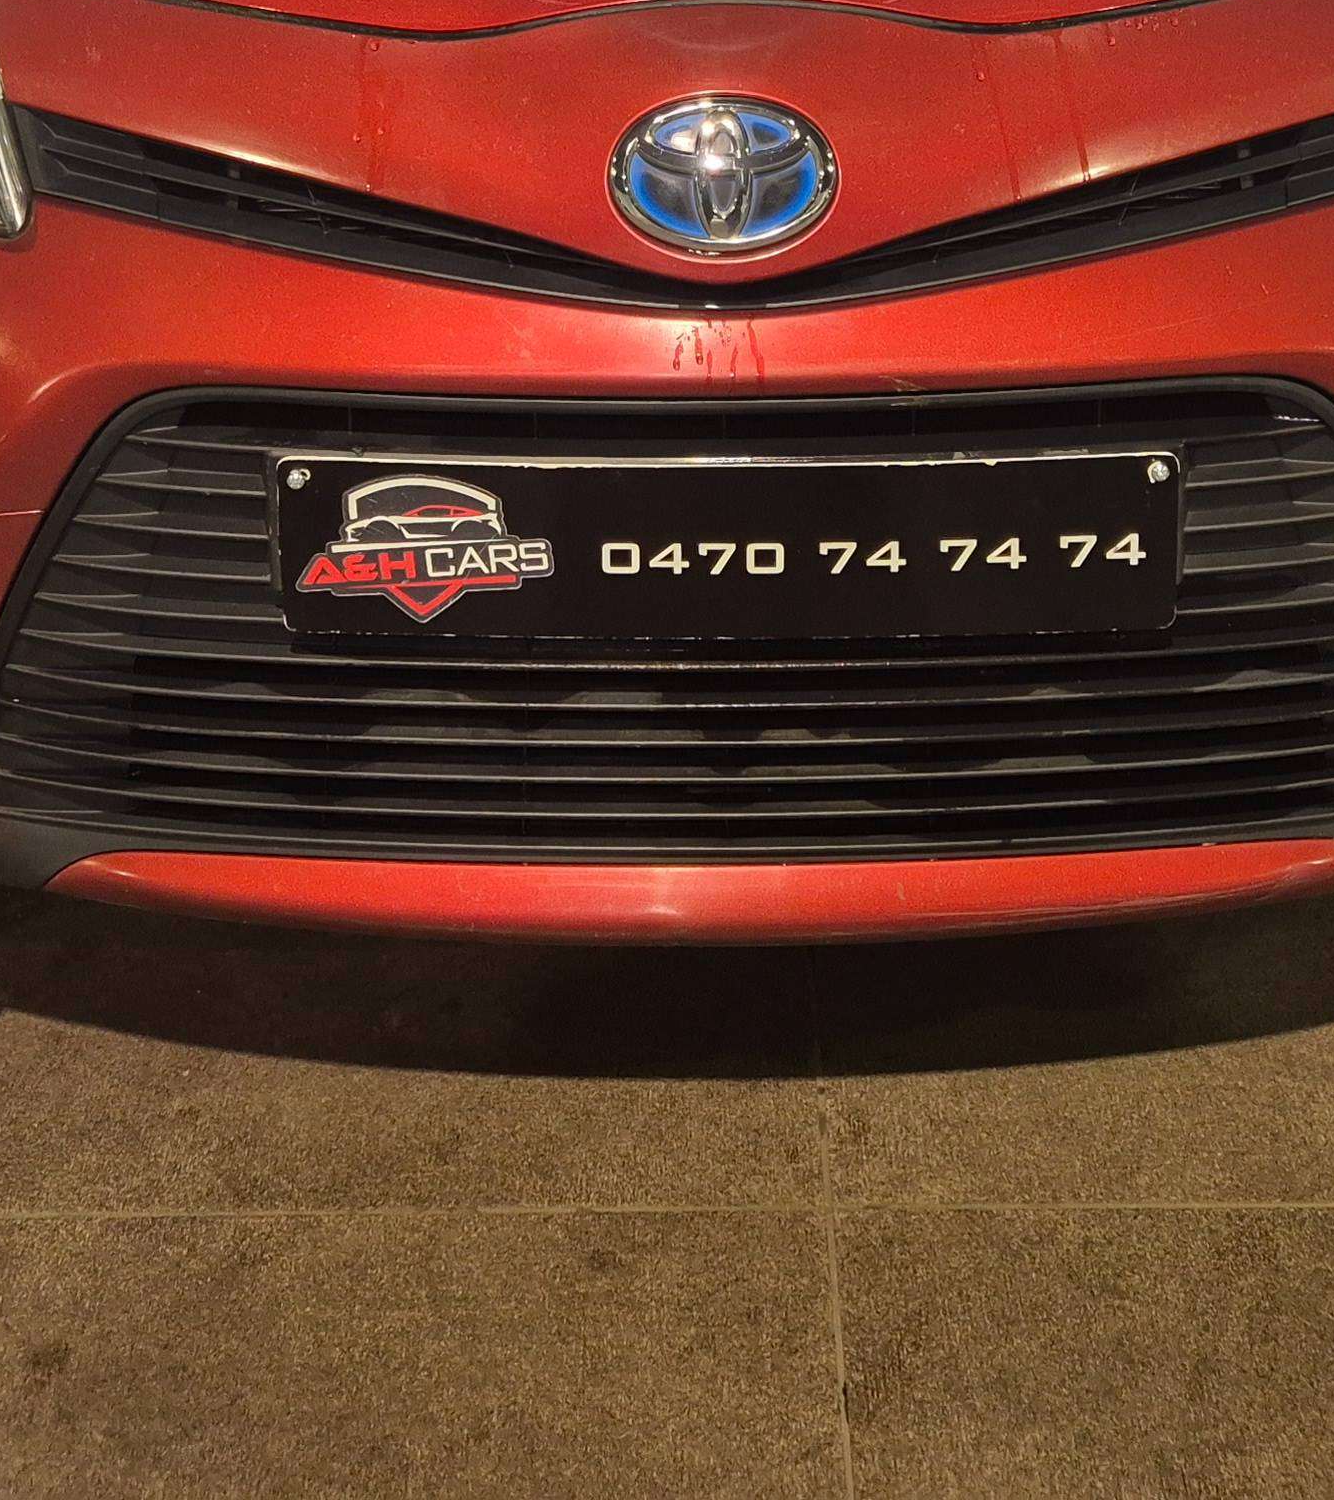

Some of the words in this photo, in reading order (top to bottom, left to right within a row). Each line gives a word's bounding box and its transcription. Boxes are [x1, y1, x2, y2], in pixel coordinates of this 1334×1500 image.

[301, 550, 416, 586] A&H
[424, 542, 549, 578] CARS
[601, 542, 785, 576] 0470
[818, 540, 907, 575] 74
[939, 537, 1028, 573] 74
[1059, 532, 1147, 569] 74
